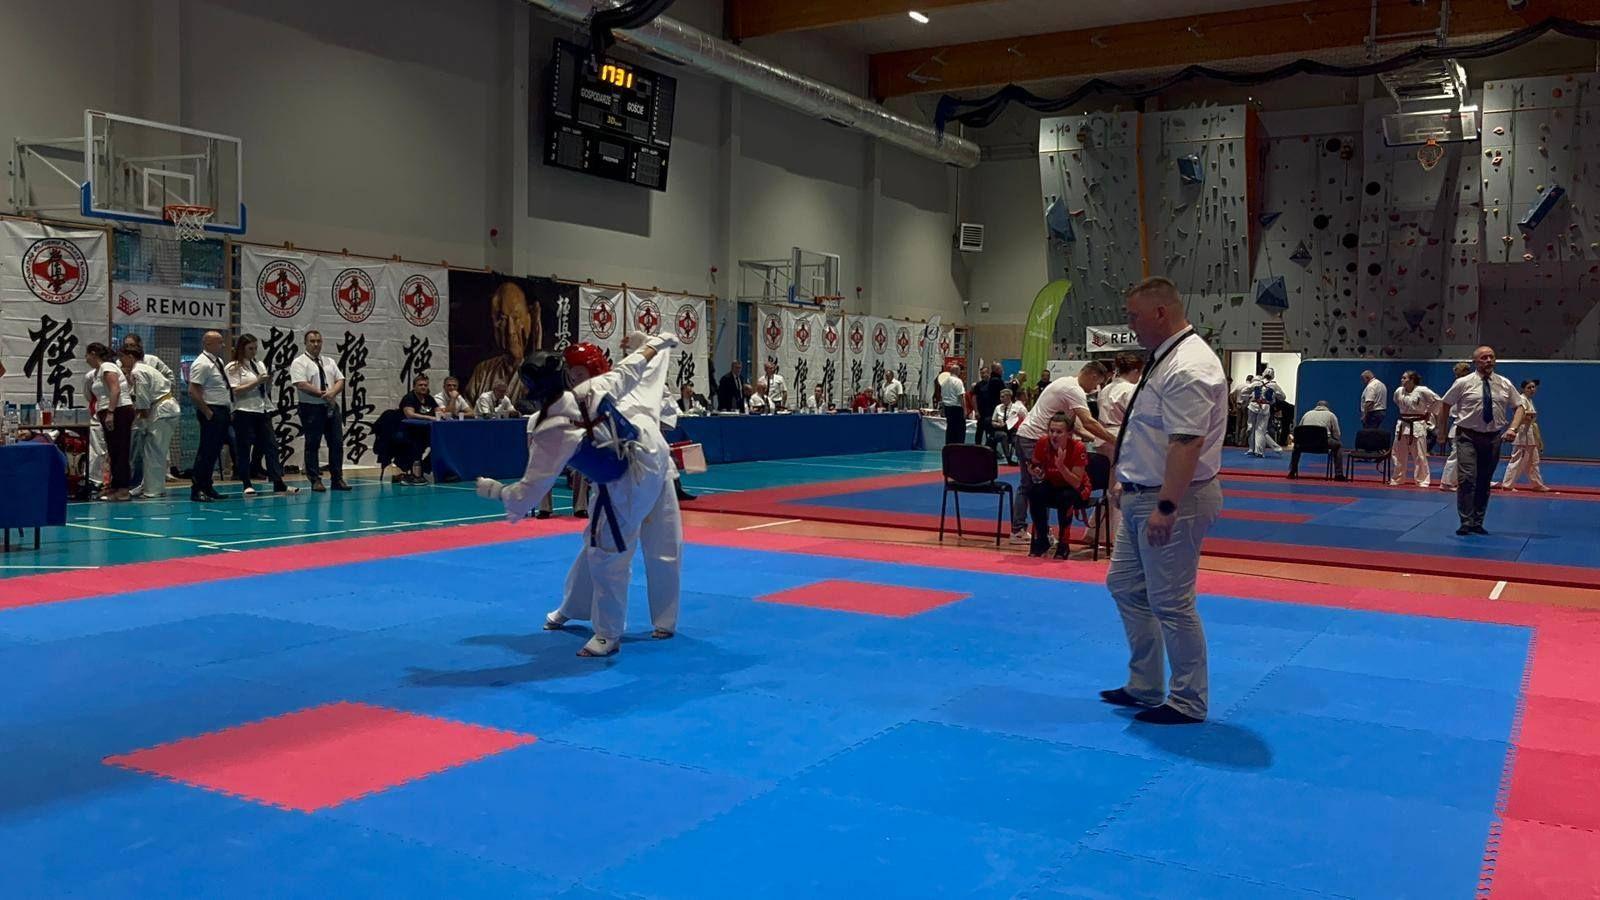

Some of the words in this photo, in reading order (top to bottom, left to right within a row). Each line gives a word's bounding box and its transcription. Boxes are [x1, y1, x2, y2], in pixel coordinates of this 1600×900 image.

[581, 87, 611, 105] GOSPODARZE
[627, 101, 644, 115] GOŚCIE
[146, 297, 226, 317] REMONT
[1110, 333, 1138, 344] REM
